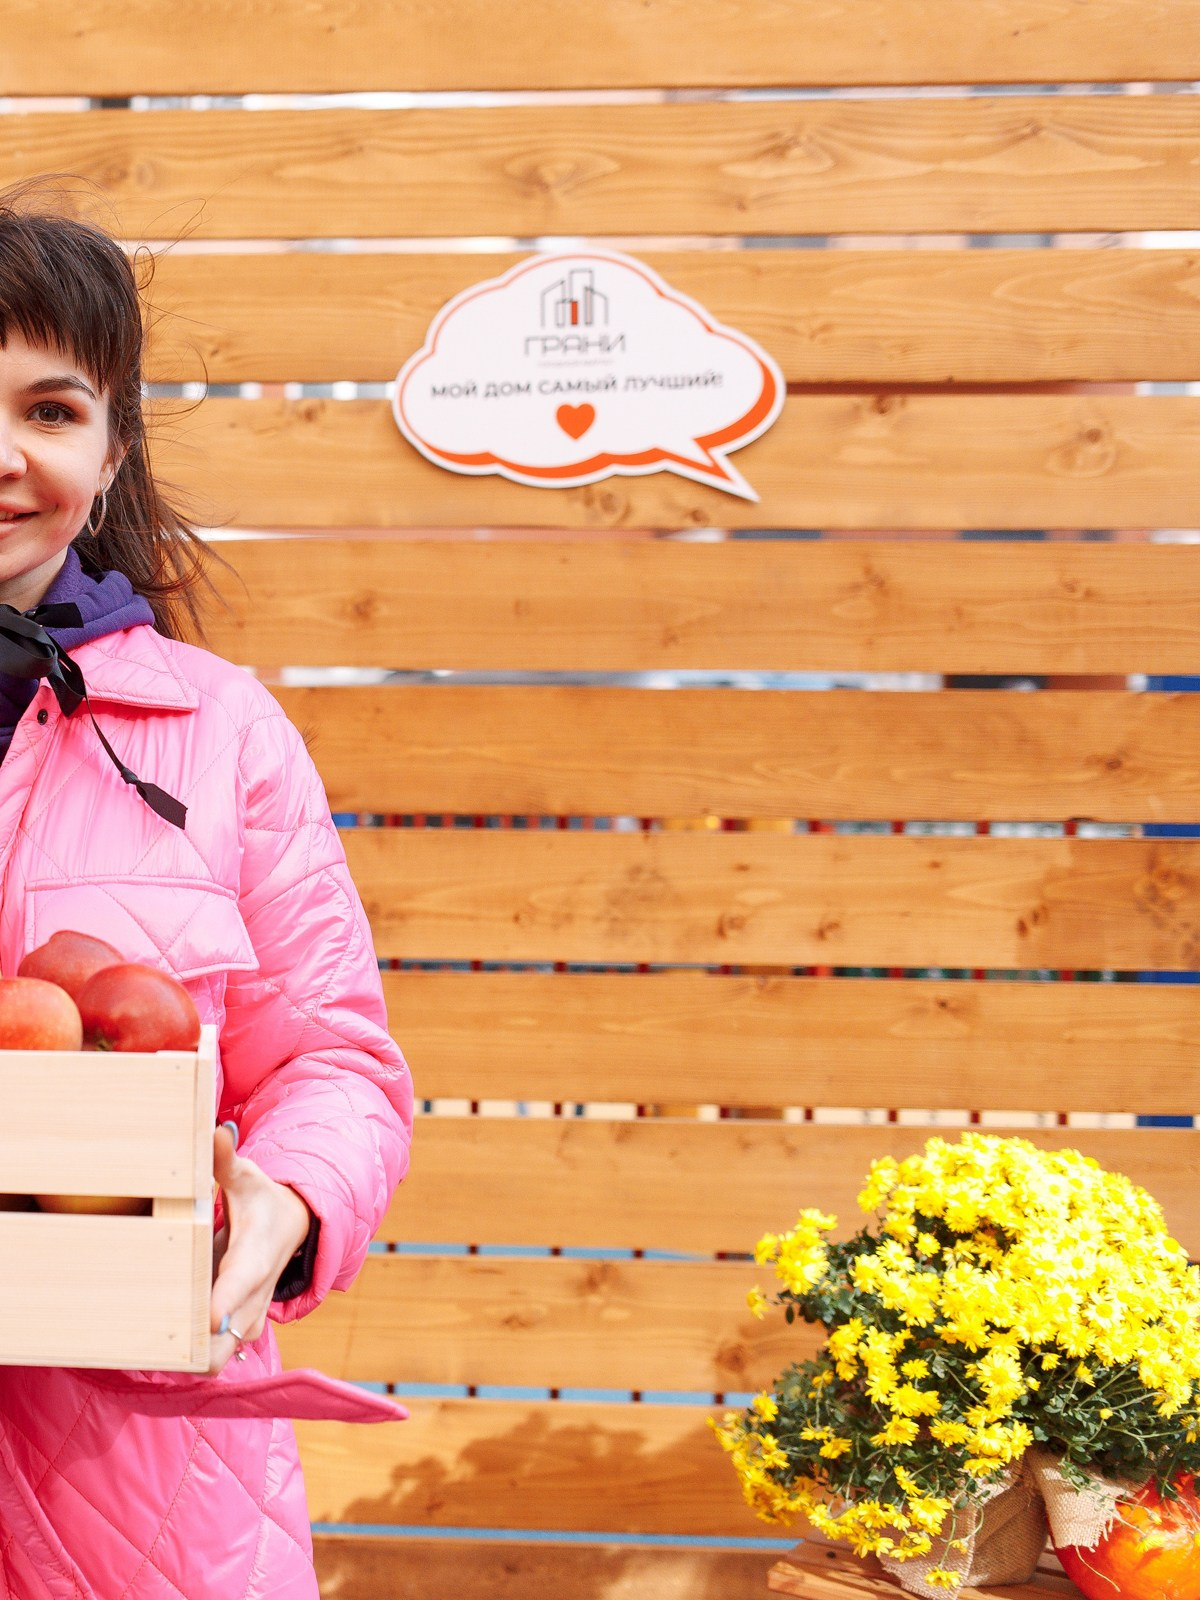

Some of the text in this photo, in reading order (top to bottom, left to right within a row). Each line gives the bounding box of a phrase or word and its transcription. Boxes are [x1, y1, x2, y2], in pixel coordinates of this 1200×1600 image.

[524, 333, 626, 357] ГРАНИ
[430, 369, 723, 399] МОЙ ДОМ САМЫЙ ЛУЧШИЙ!
